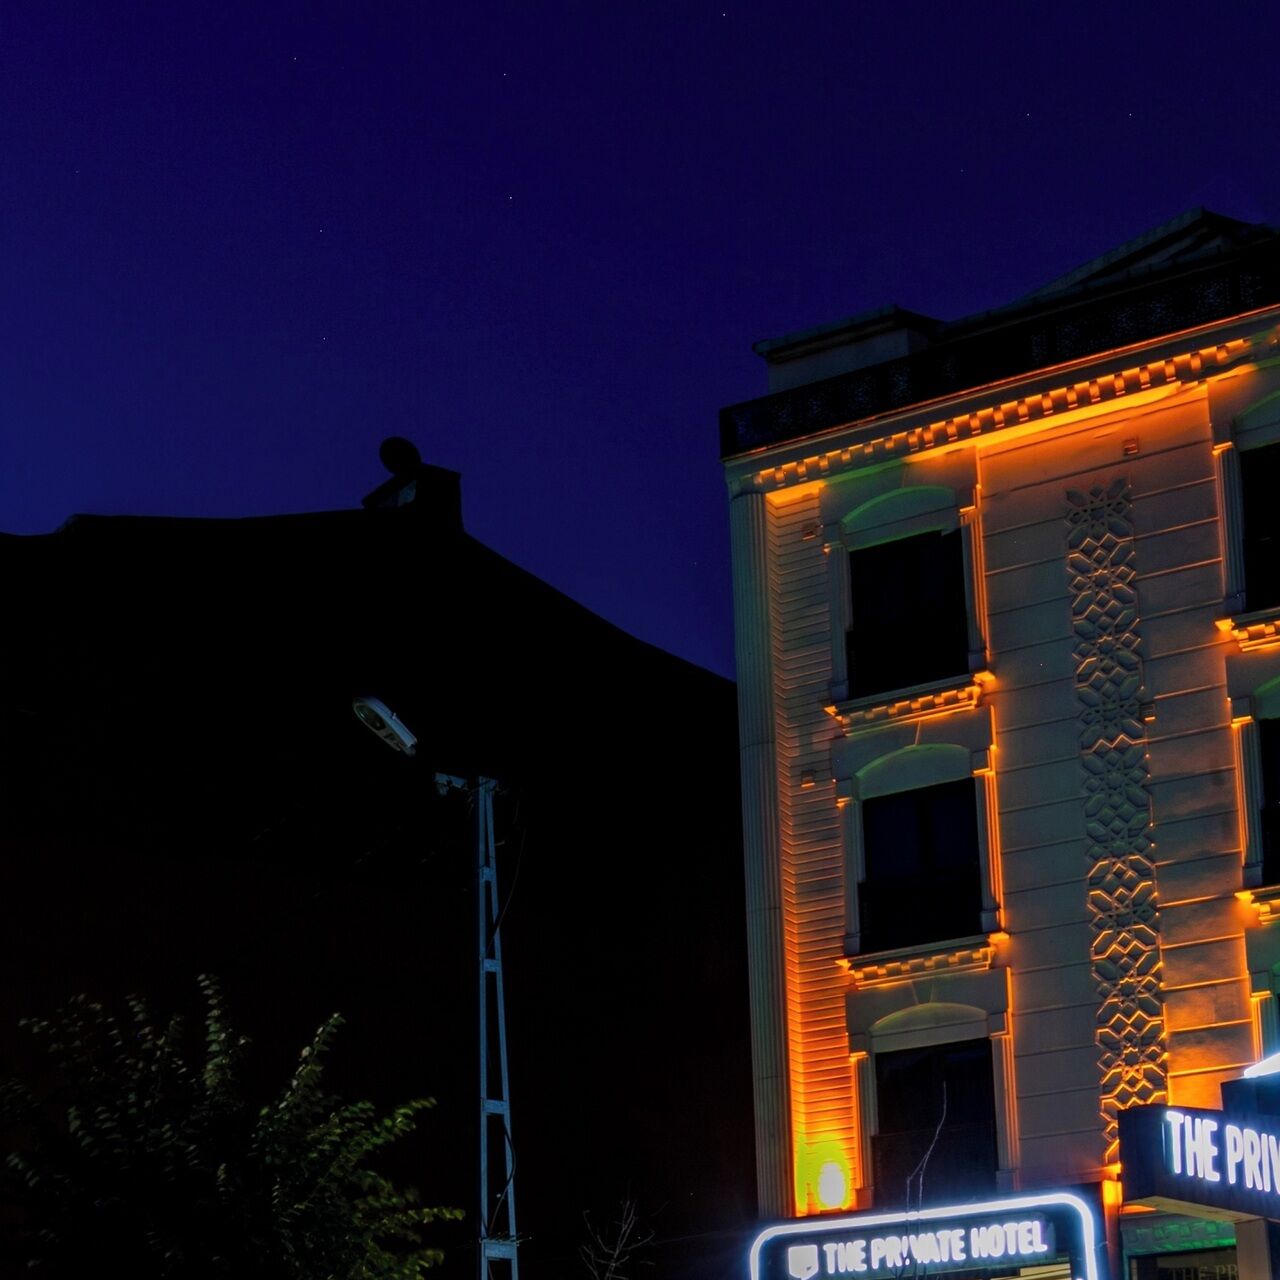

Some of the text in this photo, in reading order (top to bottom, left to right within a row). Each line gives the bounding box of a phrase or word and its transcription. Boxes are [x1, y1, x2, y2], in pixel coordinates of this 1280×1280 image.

[1166, 1111, 1220, 1182] THE
[823, 1220, 1048, 1274] THE PRIVATE HOTEL
